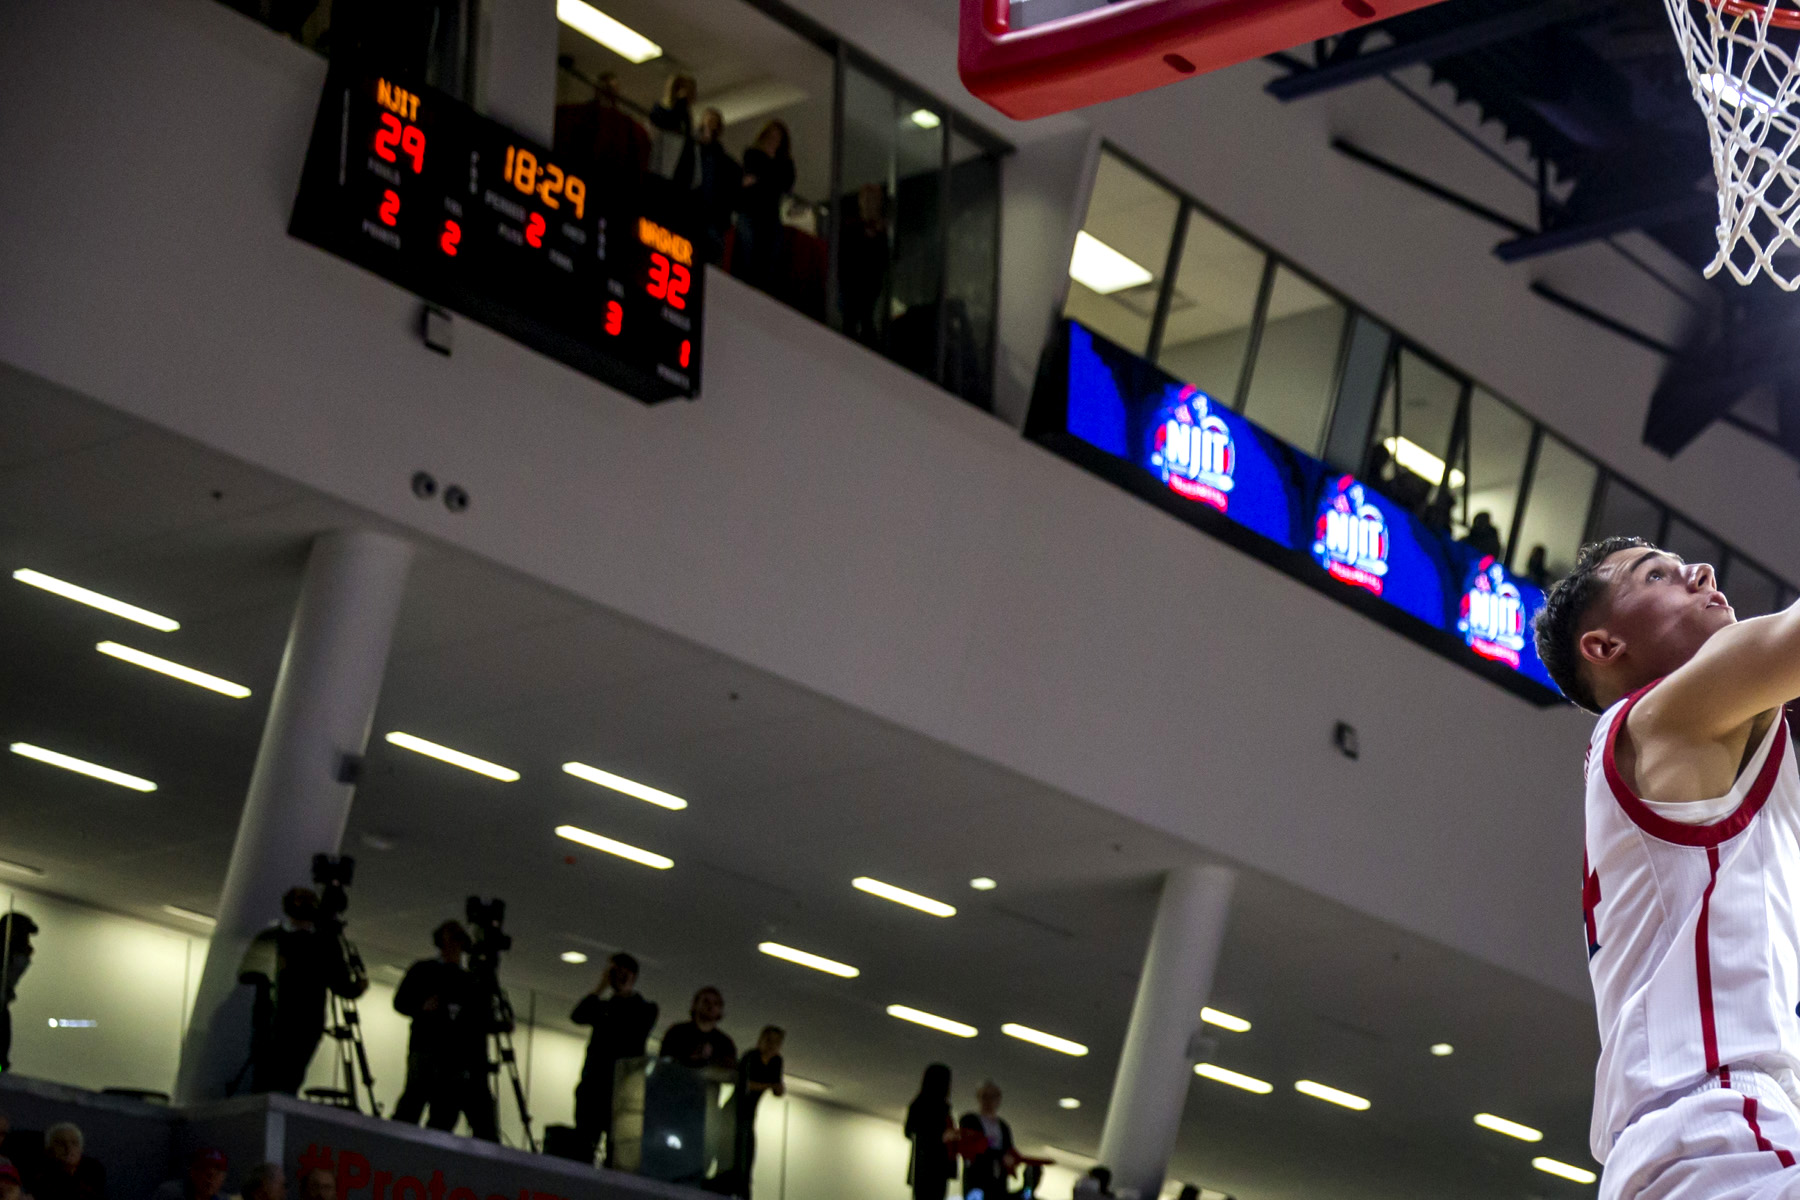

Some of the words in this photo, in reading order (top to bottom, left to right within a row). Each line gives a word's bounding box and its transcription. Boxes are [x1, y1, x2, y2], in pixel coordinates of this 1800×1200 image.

[377, 77, 421, 122] NJIT
[375, 112, 427, 175] 29
[379, 189, 401, 227] 2
[503, 144, 587, 219] 18:29
[440, 219, 462, 257] 2
[525, 211, 547, 249] 2
[646, 251, 691, 311] 32
[1165, 418, 1230, 480] NJIT
[1326, 508, 1384, 568] NJIT
[1469, 589, 1521, 645] NJIT
